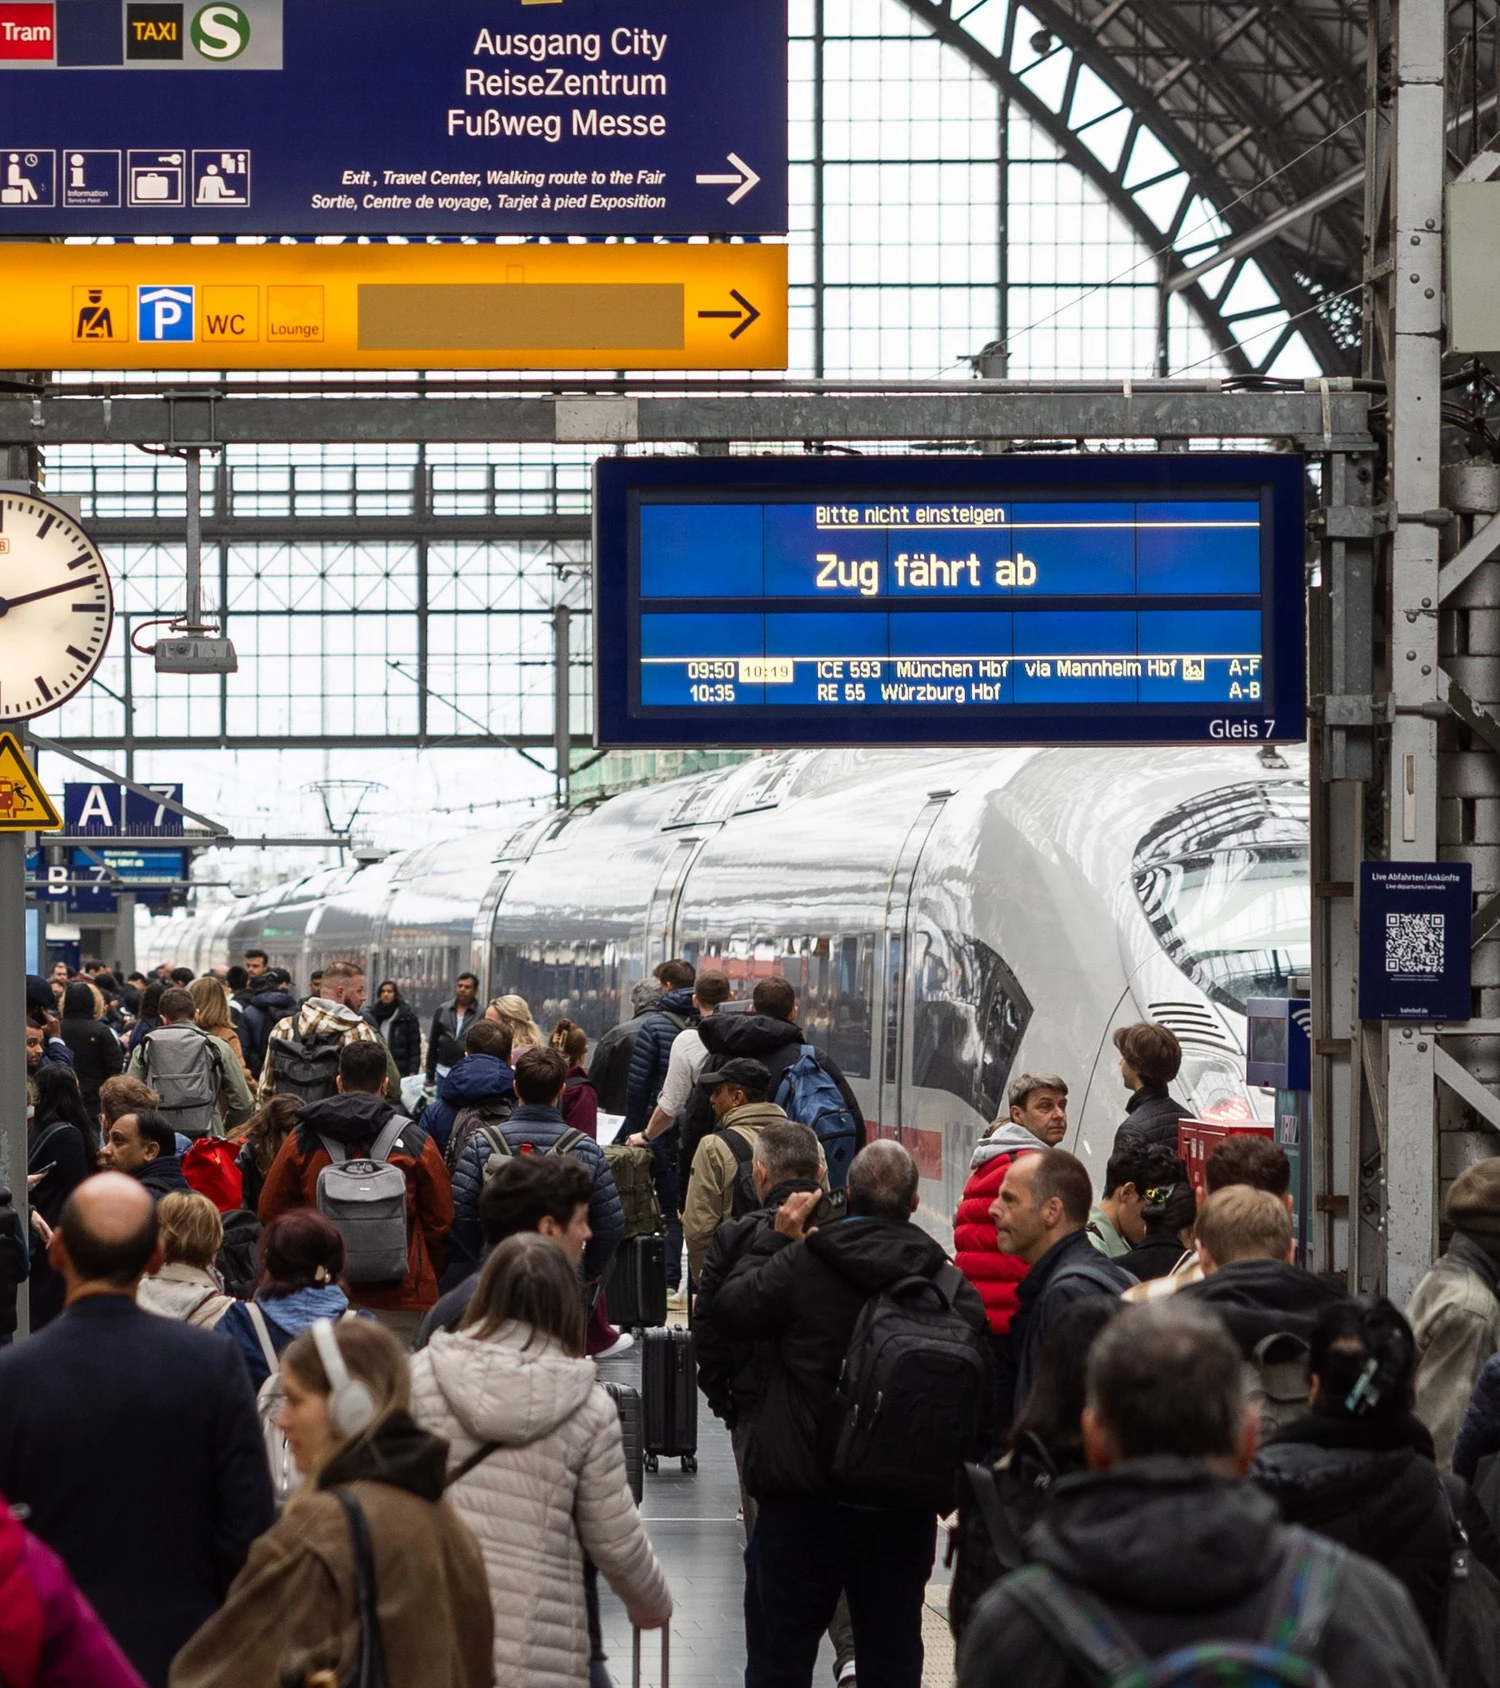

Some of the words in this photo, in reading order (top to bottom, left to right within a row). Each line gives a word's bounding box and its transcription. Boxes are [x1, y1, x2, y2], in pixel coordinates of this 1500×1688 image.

[2, 22, 52, 42] Tram
[133, 21, 178, 41] TAXI
[199, 5, 241, 59] S
[473, 28, 602, 61] Ausgang
[611, 28, 667, 60] City
[465, 68, 667, 97] ReiseZentrum
[447, 109, 562, 142] Fußweg
[571, 109, 667, 137] Messe
[341, 170, 371, 186] Exit
[383, 170, 426, 186] Travel
[429, 170, 482, 188] Center,
[487, 170, 545, 190] Walking
[548, 171, 588, 186] route
[592, 171, 606, 186] to
[609, 170, 633, 186] the
[636, 170, 666, 186] Fair
[67, 190, 108, 198] Information
[311, 193, 358, 210] Sortie,
[362, 194, 412, 210] Centre
[415, 194, 433, 209] de
[437, 194, 493, 213] voyage,
[498, 193, 538, 213] Tarjet
[542, 193, 552, 209] à
[555, 193, 588, 213] pied
[590, 193, 666, 213] Exposition
[154, 301, 182, 339] P
[206, 314, 246, 335] WC
[271, 323, 319, 337] Lounge
[816, 506, 858, 523] Bitte
[865, 506, 909, 523] nicht
[915, 506, 1005, 525] einsteigen
[816, 554, 878, 596] Zug
[894, 553, 982, 587] fährt
[995, 553, 1037, 587] ab
[688, 662, 735, 680] 09:50
[743, 665, 790, 679] 10:19
[817, 661, 844, 679] ICE
[849, 661, 881, 679] 593
[896, 660, 973, 679] München
[979, 660, 1008, 678] Hbf
[1025, 660, 1051, 678] via
[1057, 659, 1142, 678] Mannheim
[1148, 659, 1177, 677] Hbf
[1229, 659, 1260, 677] A-F
[690, 684, 735, 702] 10:35
[817, 684, 838, 701] RE
[844, 684, 866, 701] 55
[881, 683, 965, 704] Würzburg
[971, 683, 1000, 700] Hbf
[1229, 681, 1261, 699] A-B
[1209, 720, 1258, 739] Gleis
[1264, 720, 1276, 738] 7
[78, 785, 113, 827] A
[150, 786, 176, 826] 7
[48, 867, 69, 894] B
[89, 866, 106, 894] 7
